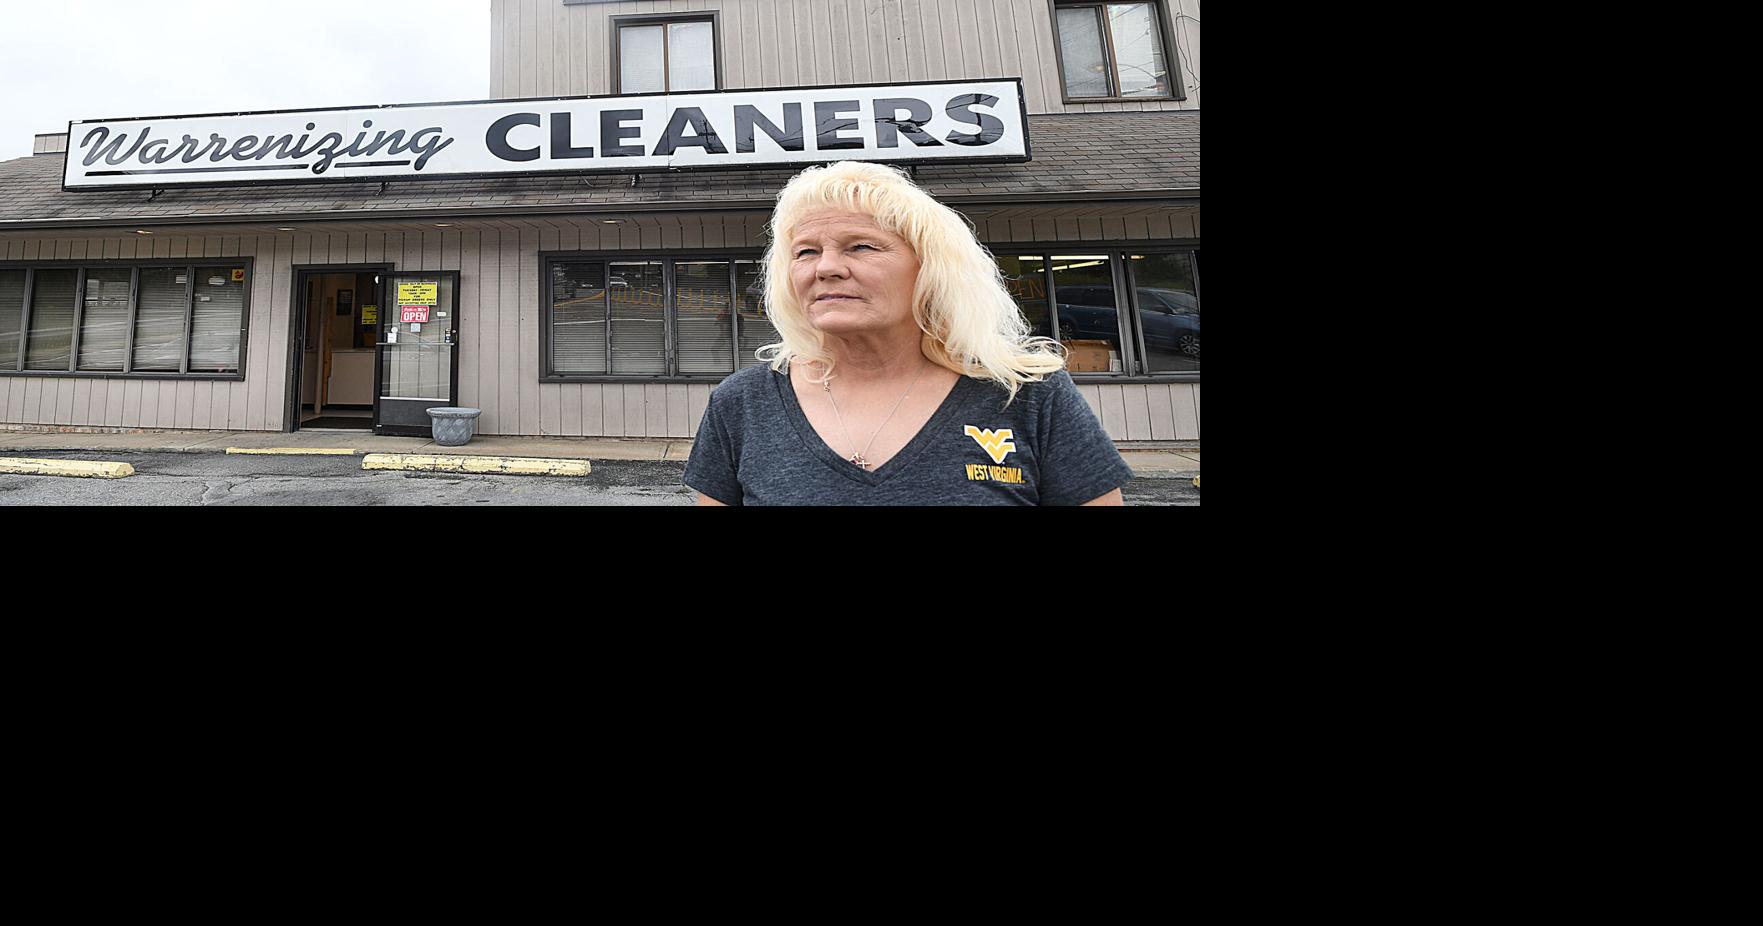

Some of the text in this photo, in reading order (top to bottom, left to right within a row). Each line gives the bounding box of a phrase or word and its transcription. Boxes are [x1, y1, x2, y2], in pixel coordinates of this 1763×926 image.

[80, 93, 1004, 174] Warrenizing CLEANERS
[403, 311, 427, 321] OPEN
[965, 464, 1022, 483] WEST VIRGINIA
